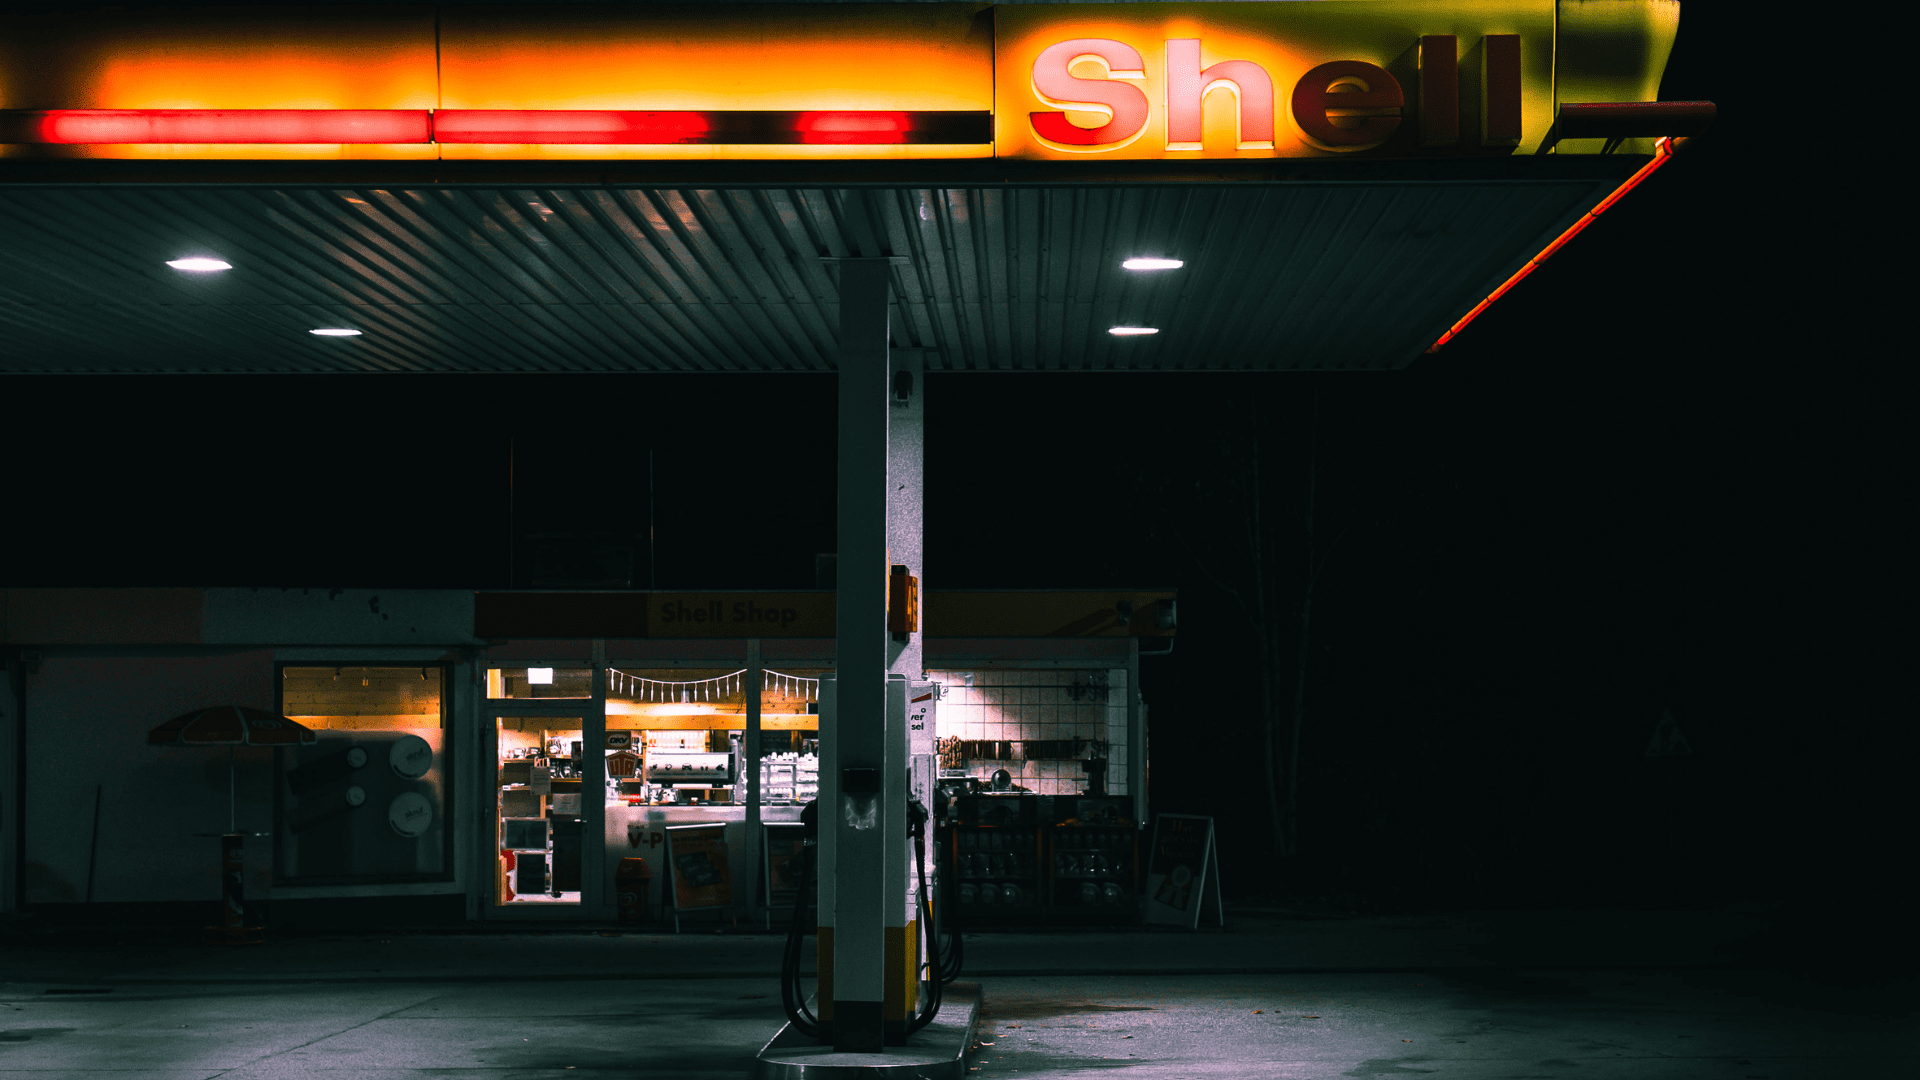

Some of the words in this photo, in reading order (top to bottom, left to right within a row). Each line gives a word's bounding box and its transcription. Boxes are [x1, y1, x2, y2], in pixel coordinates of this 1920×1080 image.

[1029, 34, 1522, 153] Shell
[661, 600, 722, 622] Shell
[733, 600, 798, 628] Shop
[608, 736, 628, 744] DKV
